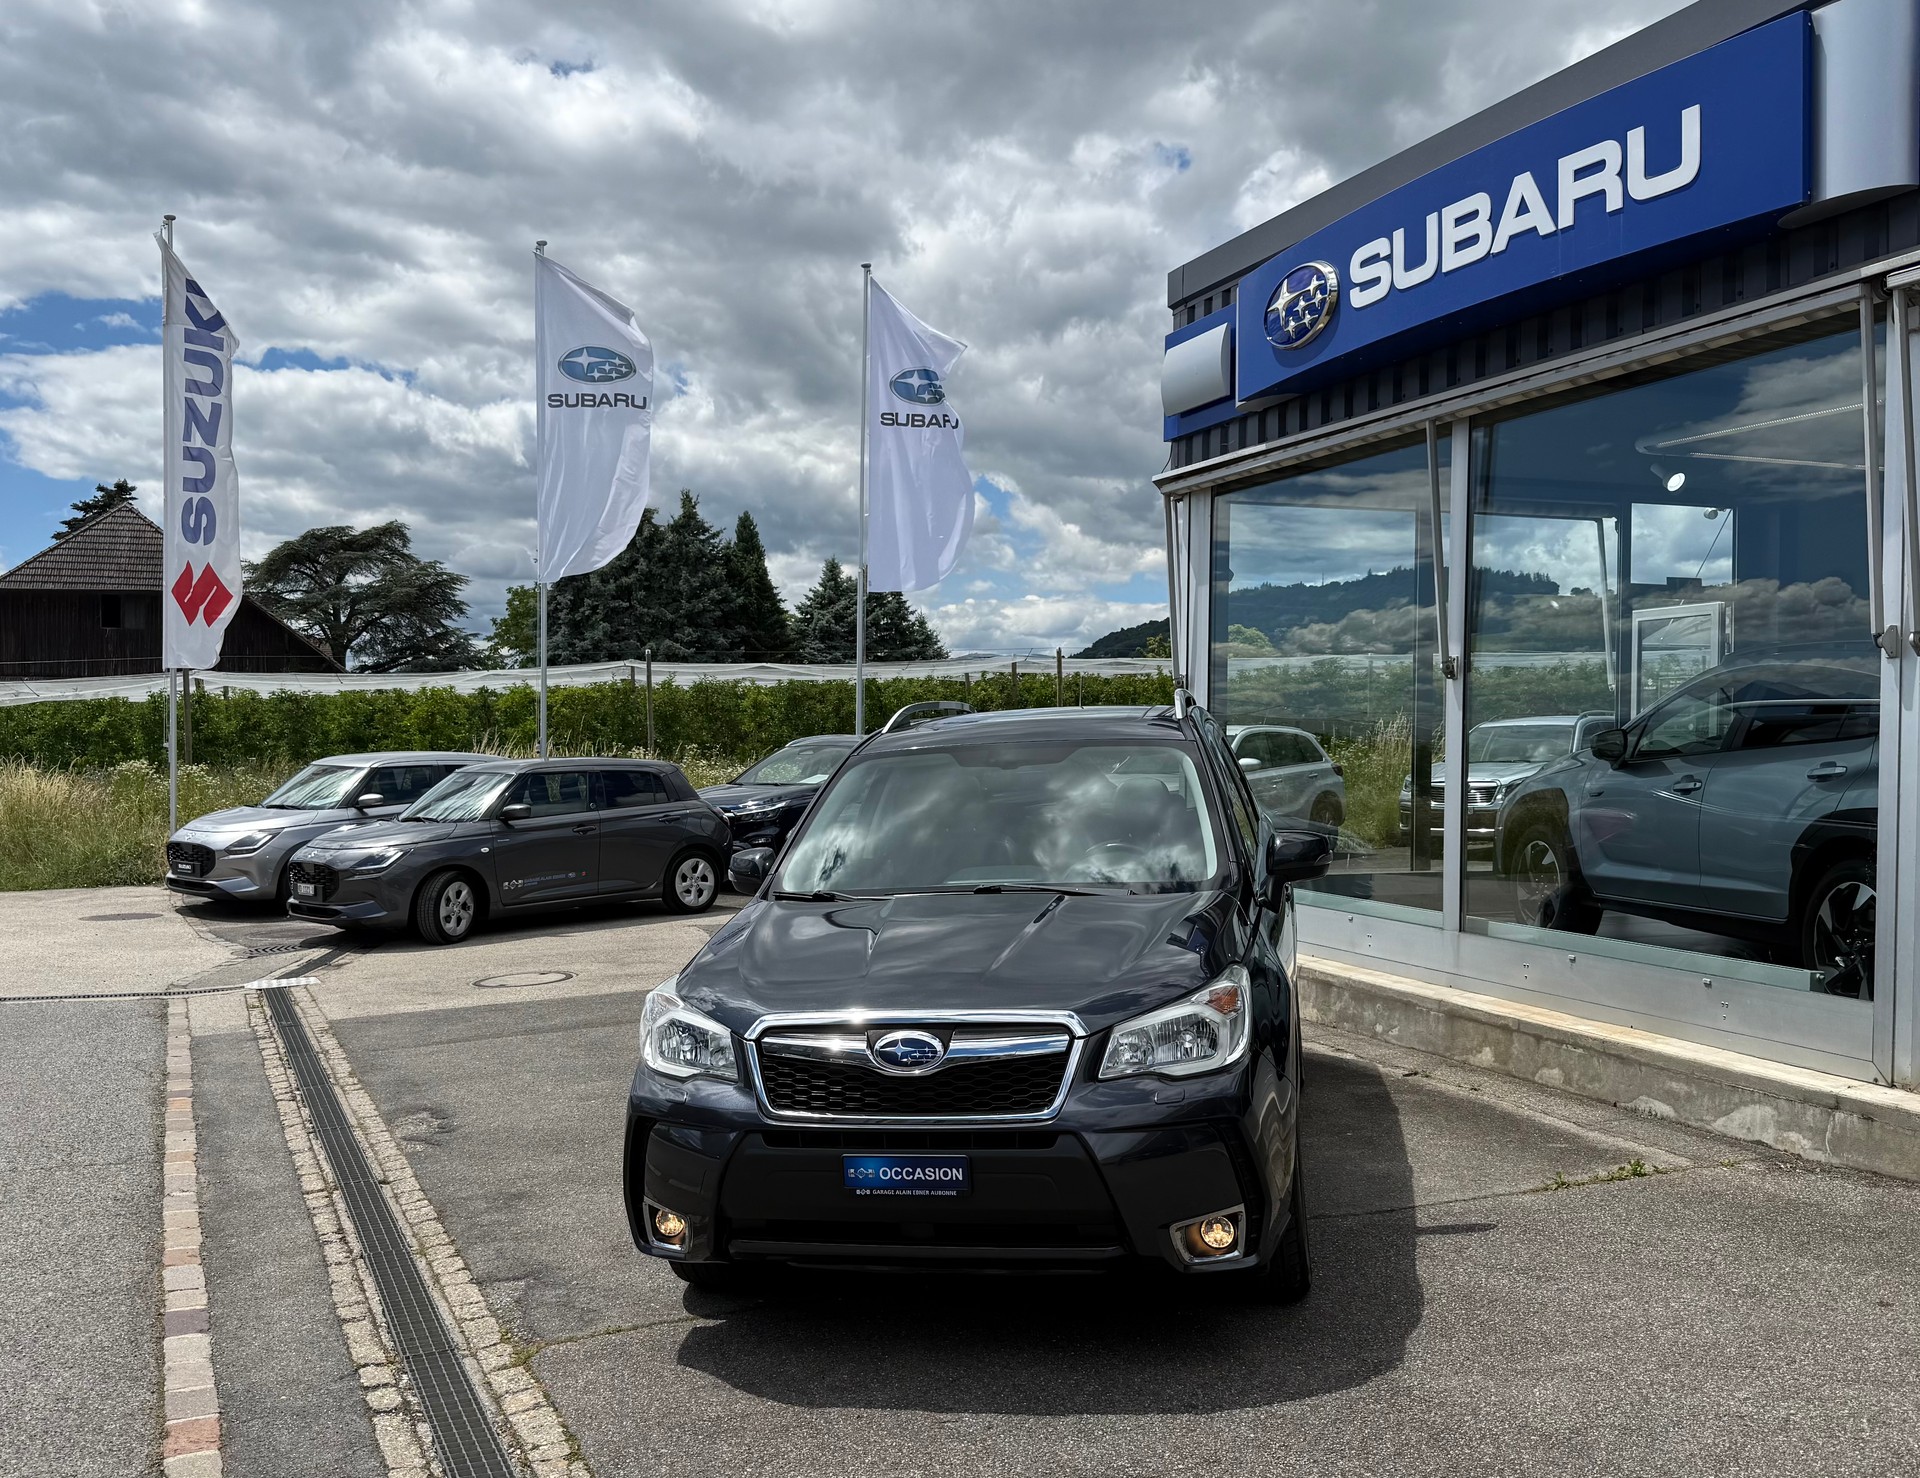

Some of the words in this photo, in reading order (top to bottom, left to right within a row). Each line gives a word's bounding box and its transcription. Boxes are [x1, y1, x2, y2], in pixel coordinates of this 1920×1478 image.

[1349, 104, 1700, 309] SUBARU
[181, 277, 227, 546] SUZUKI
[547, 393, 647, 410] SUBARU
[879, 1167, 963, 1180] OCCASION
